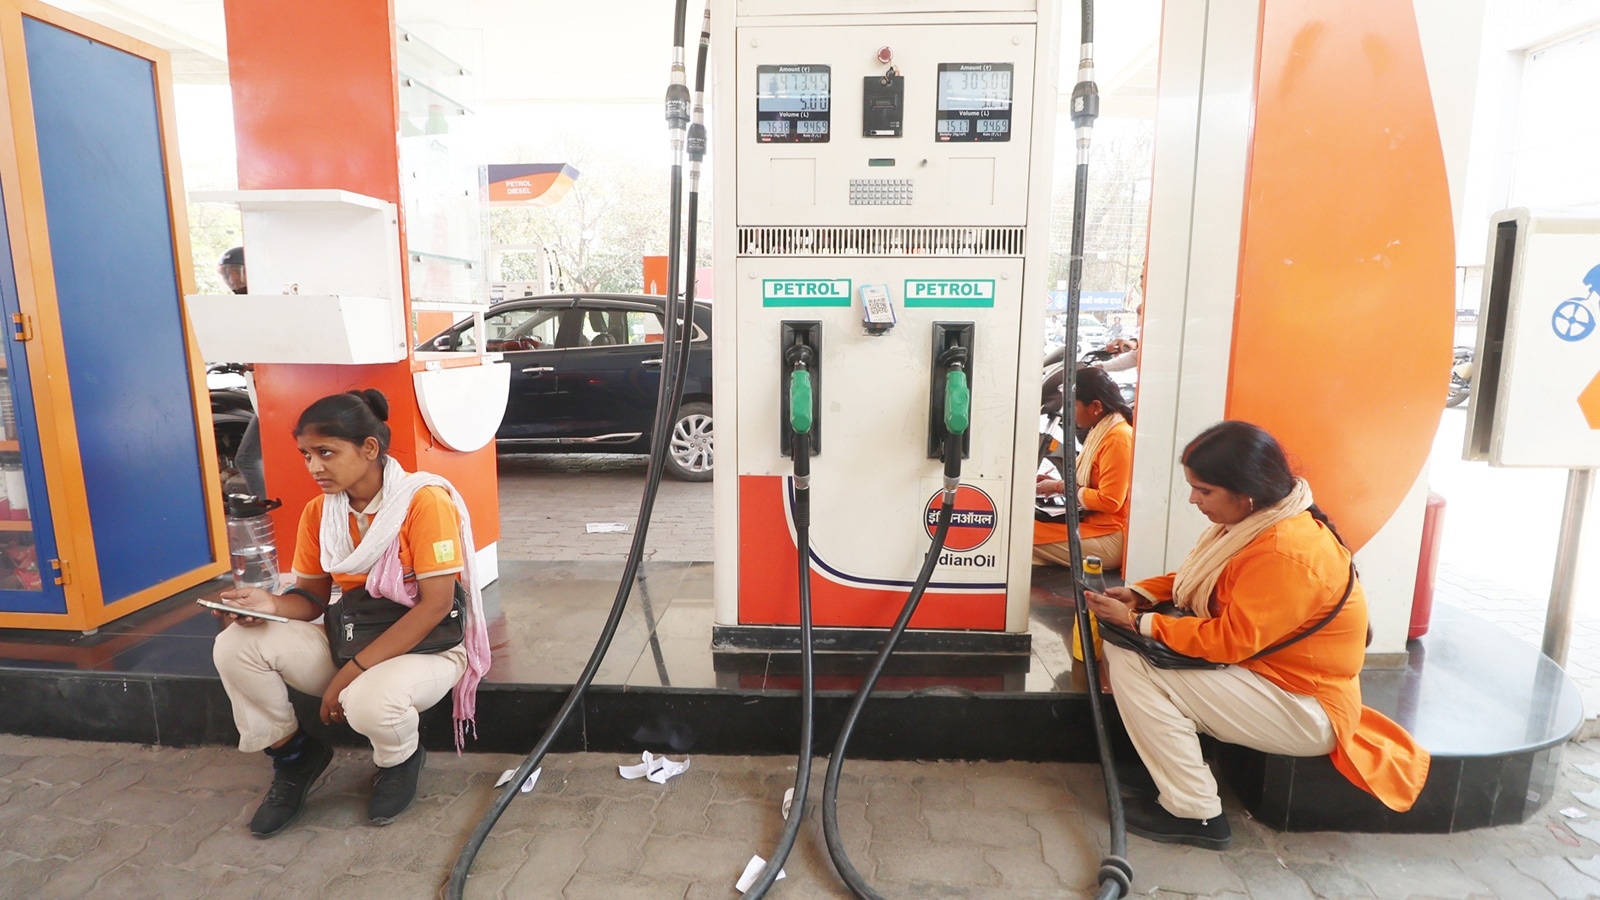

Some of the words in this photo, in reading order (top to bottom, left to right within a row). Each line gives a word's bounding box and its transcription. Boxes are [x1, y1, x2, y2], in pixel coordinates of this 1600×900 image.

[800, 94, 827, 110] 5.00
[773, 282, 840, 296] PETROL
[915, 283, 983, 296] PETROL
[924, 552, 996, 567] IdianOil
